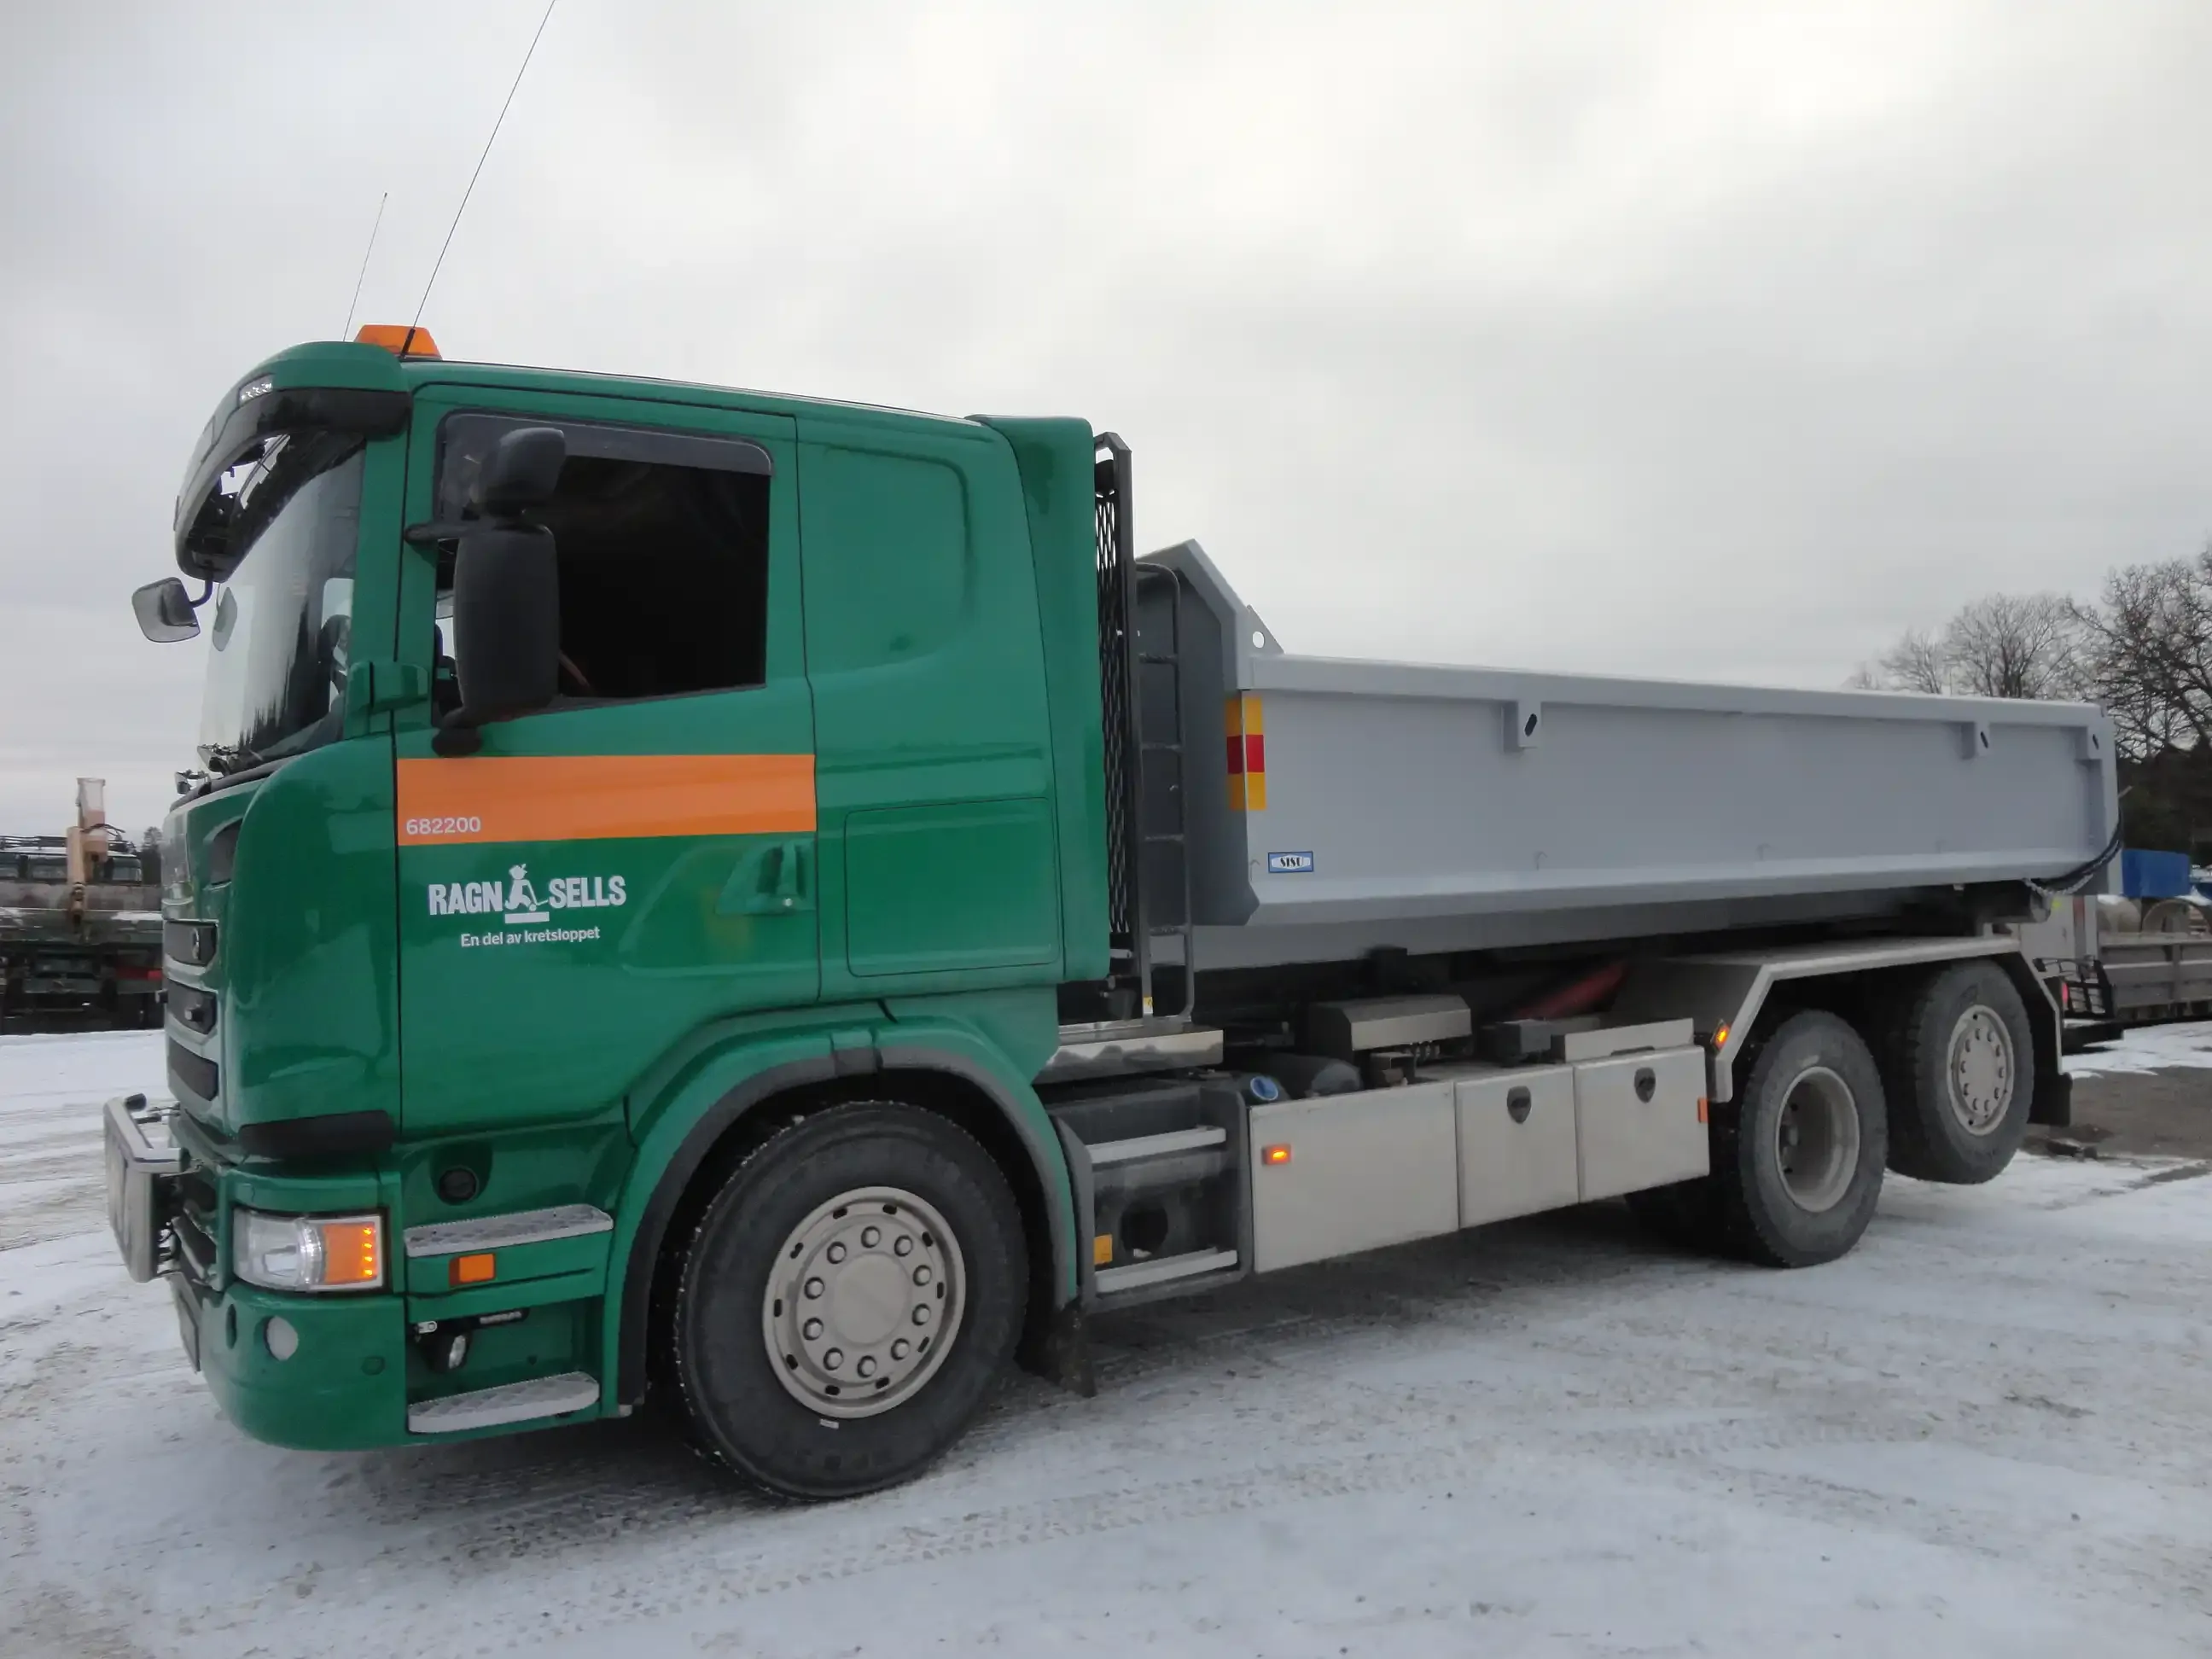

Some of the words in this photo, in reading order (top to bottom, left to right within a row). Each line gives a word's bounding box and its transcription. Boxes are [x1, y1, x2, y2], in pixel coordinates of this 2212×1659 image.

[405, 817, 481, 835] 682200
[1280, 857, 1305, 867] SISU
[428, 882, 503, 916] RAGN
[549, 876, 626, 909] SELLS
[461, 934, 480, 947] En
[483, 932, 504, 946] del
[507, 932, 521, 944] av
[525, 927, 601, 943] kretsloppet
